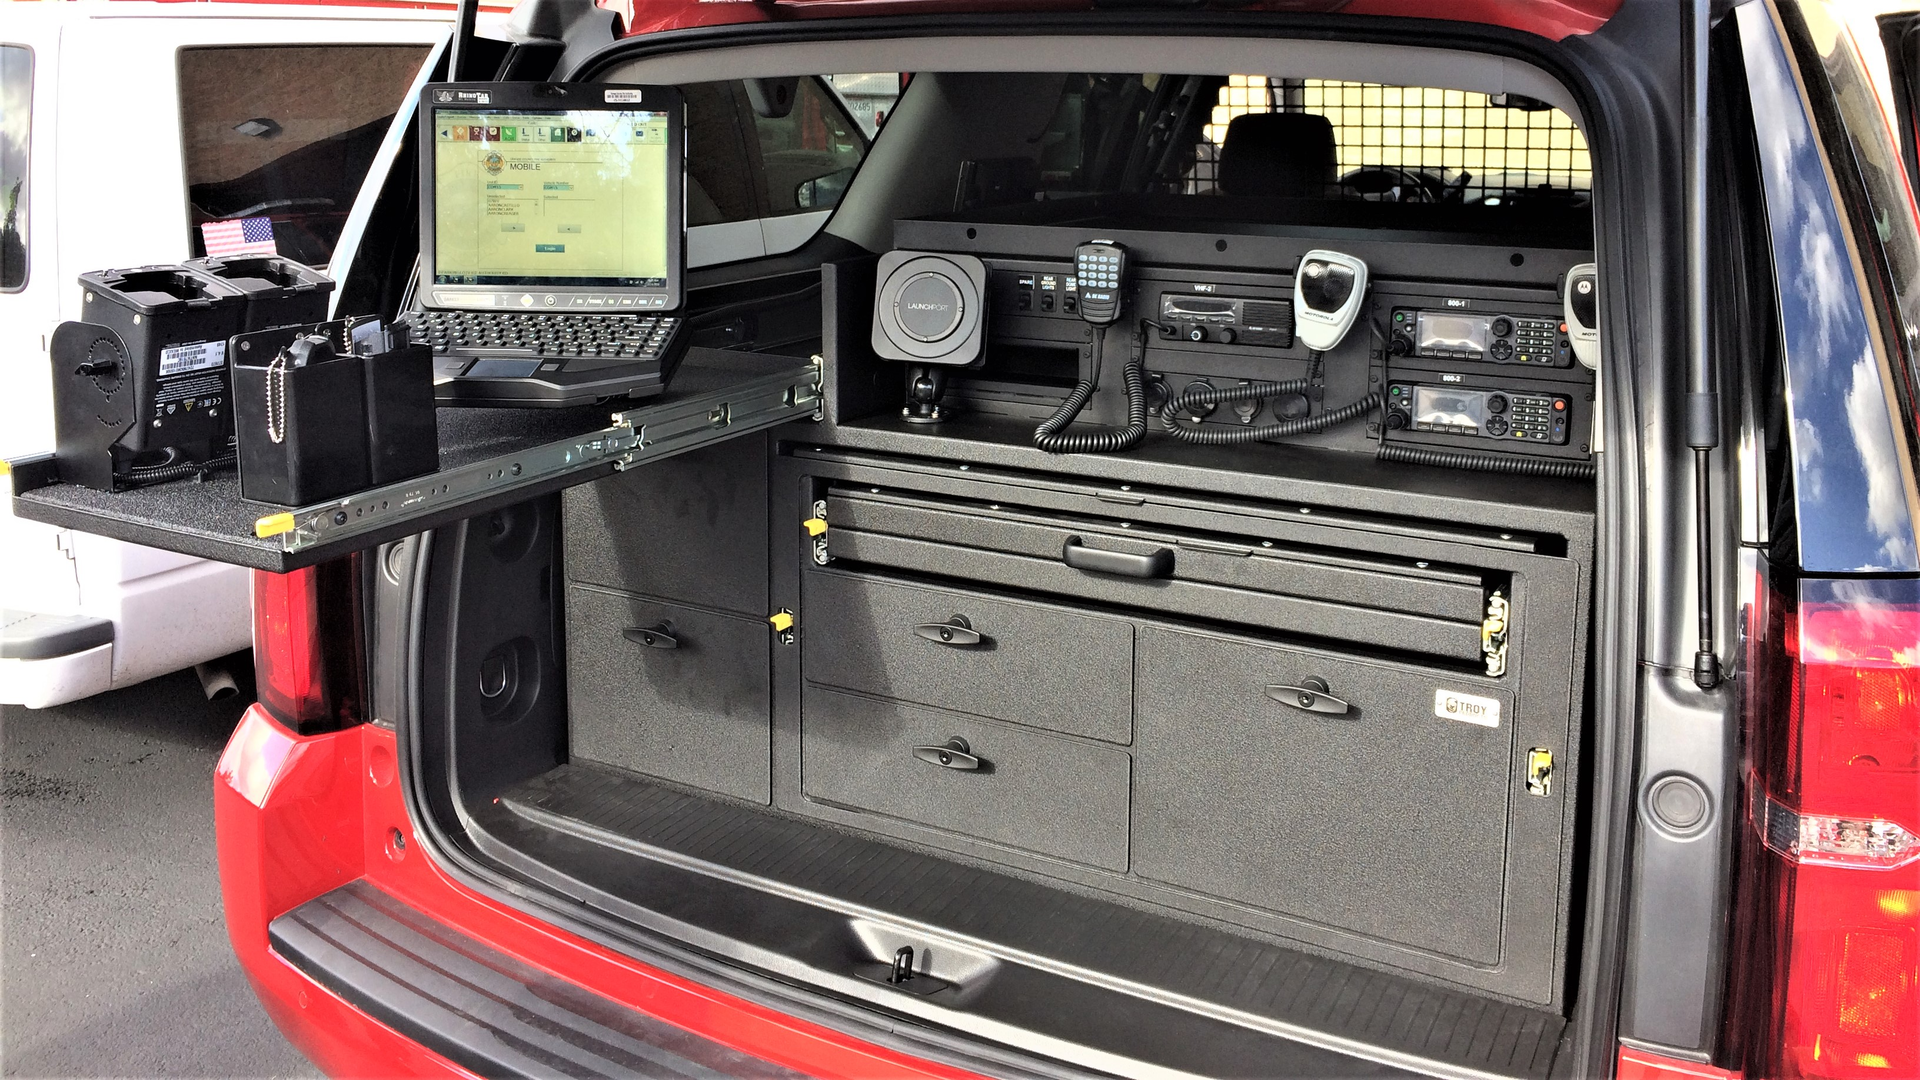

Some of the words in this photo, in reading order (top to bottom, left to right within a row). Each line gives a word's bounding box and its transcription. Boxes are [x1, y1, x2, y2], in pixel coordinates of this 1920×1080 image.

[908, 303, 948, 311] LAUNCHPORT
[1305, 311, 1333, 321] MOTOROLA
[1460, 702, 1487, 715] TROY
